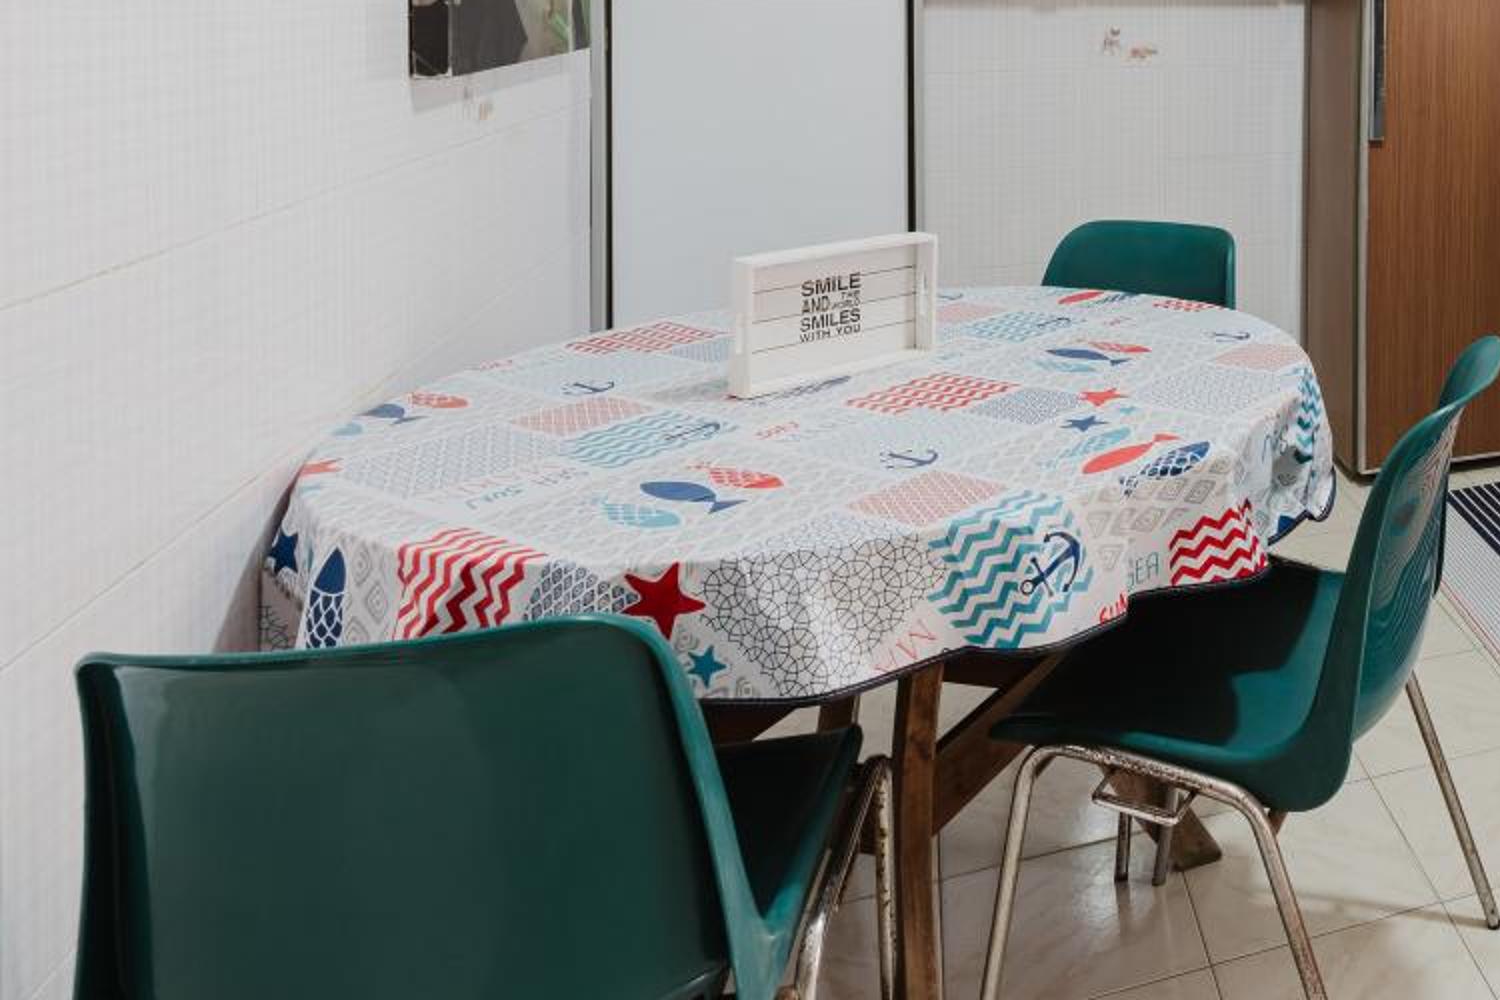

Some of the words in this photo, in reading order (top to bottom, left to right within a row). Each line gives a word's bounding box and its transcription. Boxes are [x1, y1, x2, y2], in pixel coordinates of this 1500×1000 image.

[801, 272, 861, 297] SMILE
[801, 295, 830, 314] AND
[800, 308, 861, 332] SMILES
[800, 328, 831, 343] WITH
[836, 324, 861, 336] YOU
